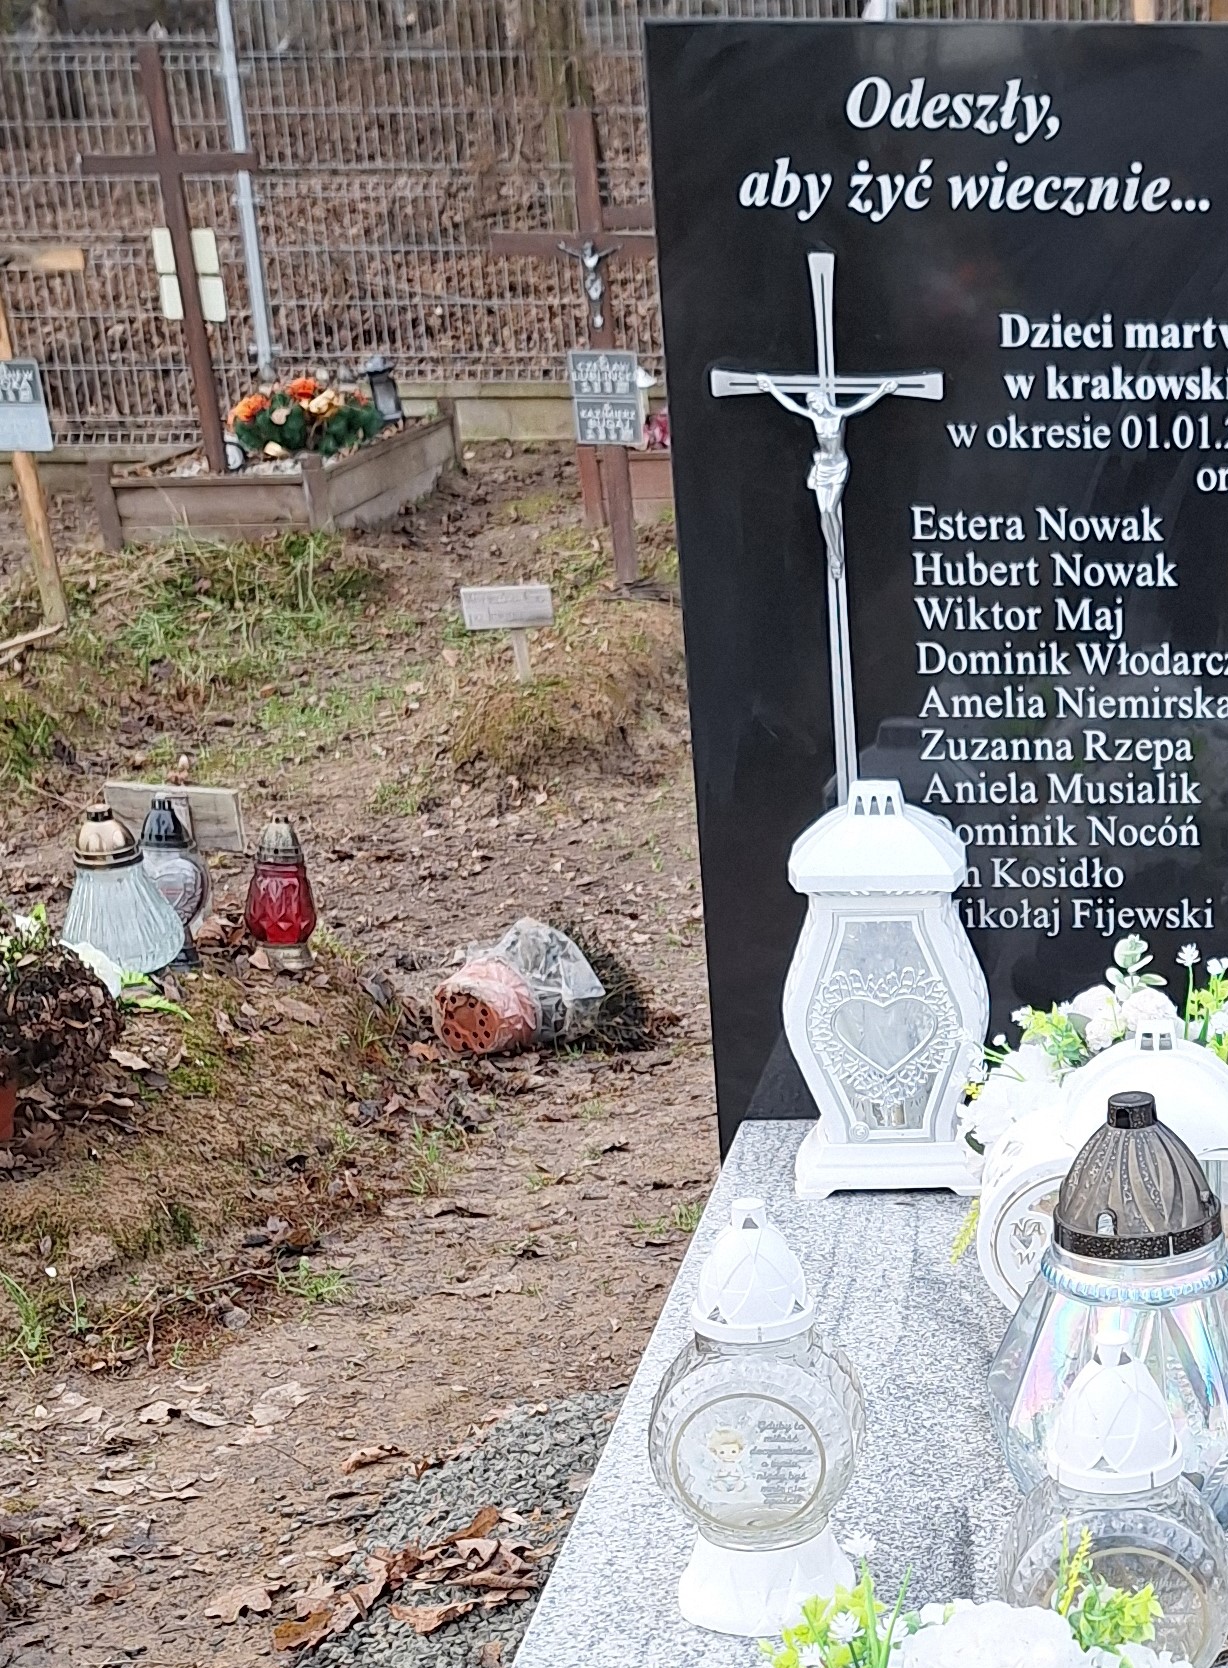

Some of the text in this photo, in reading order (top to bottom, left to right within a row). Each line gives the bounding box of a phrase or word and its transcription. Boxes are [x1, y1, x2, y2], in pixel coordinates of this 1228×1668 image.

[846, 76, 1060, 144] Odeszły,
[739, 157, 1210, 223] aby żyć wiecznie...
[999, 313, 1114, 349] Dzieci
[1003, 374, 1035, 400] w
[946, 424, 978, 448] w
[986, 414, 1111, 449] okresie
[910, 506, 1026, 541] Estera
[1035, 506, 1164, 542] Nowak
[912, 551, 1040, 587] Hubert
[1050, 552, 1178, 587] Nowak
[913, 595, 1042, 631] Wiktor
[1054, 597, 1123, 641] Maj
[916, 641, 1072, 675] Dominik
[918, 685, 1047, 719] Amelia
[920, 728, 1075, 761] Zuzanna
[1082, 729, 1194, 770] Rzepa
[922, 771, 1039, 804] Aniela
[1047, 771, 1202, 805] Musialik
[950, 814, 1078, 847] ominik
[1086, 815, 1200, 847] Nocóń
[990, 856, 1124, 888] Kosidło
[953, 897, 1214, 937] ikołaj Fijewski
